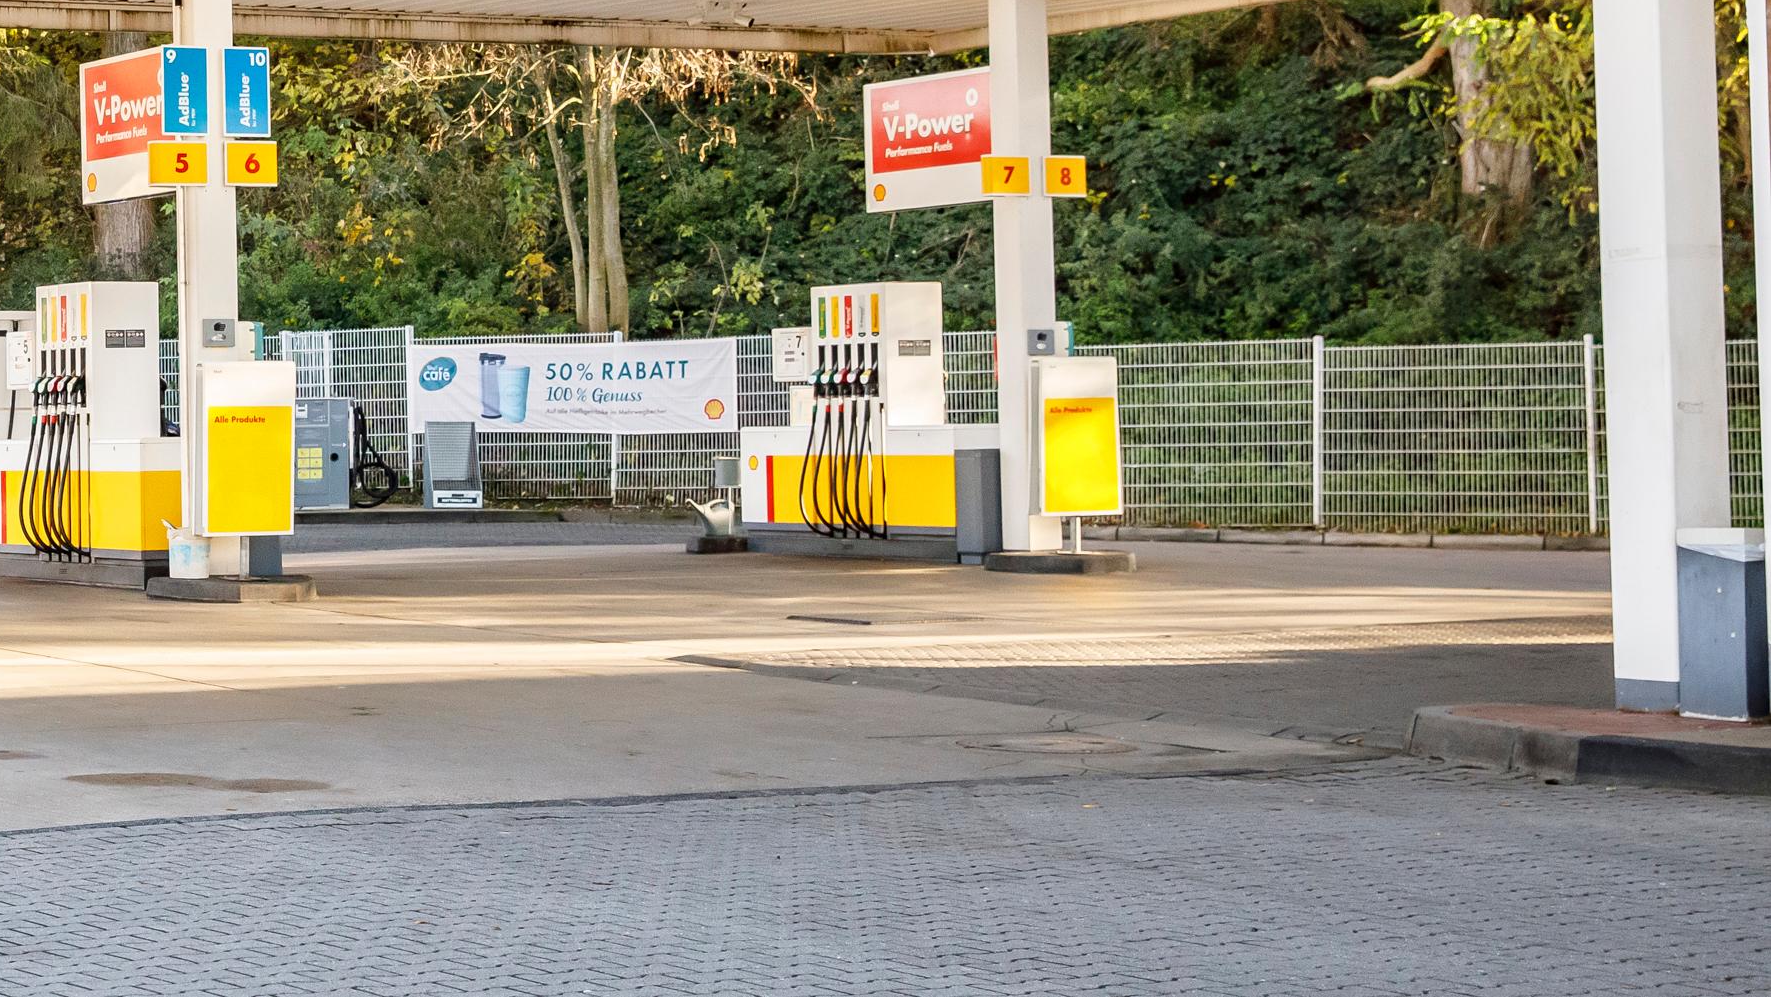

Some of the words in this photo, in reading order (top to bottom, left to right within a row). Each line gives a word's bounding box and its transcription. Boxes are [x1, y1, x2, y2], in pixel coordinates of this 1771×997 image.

[165, 49, 177, 63] 9
[249, 52, 266, 67] 10
[93, 81, 107, 94] Shell
[94, 94, 163, 126] V-Power
[96, 128, 133, 145] Performance
[133, 125, 148, 140] Fuels
[882, 112, 975, 142] V-Power
[885, 144, 933, 159] Performance
[933, 140, 953, 153] Fuels
[175, 153, 189, 173] 5
[245, 153, 260, 173] 6
[1003, 166, 1015, 184] 7
[1060, 167, 1072, 186] 8
[23, 340, 29, 354] 5
[795, 336, 802, 349] 7
[423, 367, 451, 382] café
[602, 360, 689, 381] RABATT
[545, 386, 573, 402] 100
[592, 387, 643, 404] Genuss
